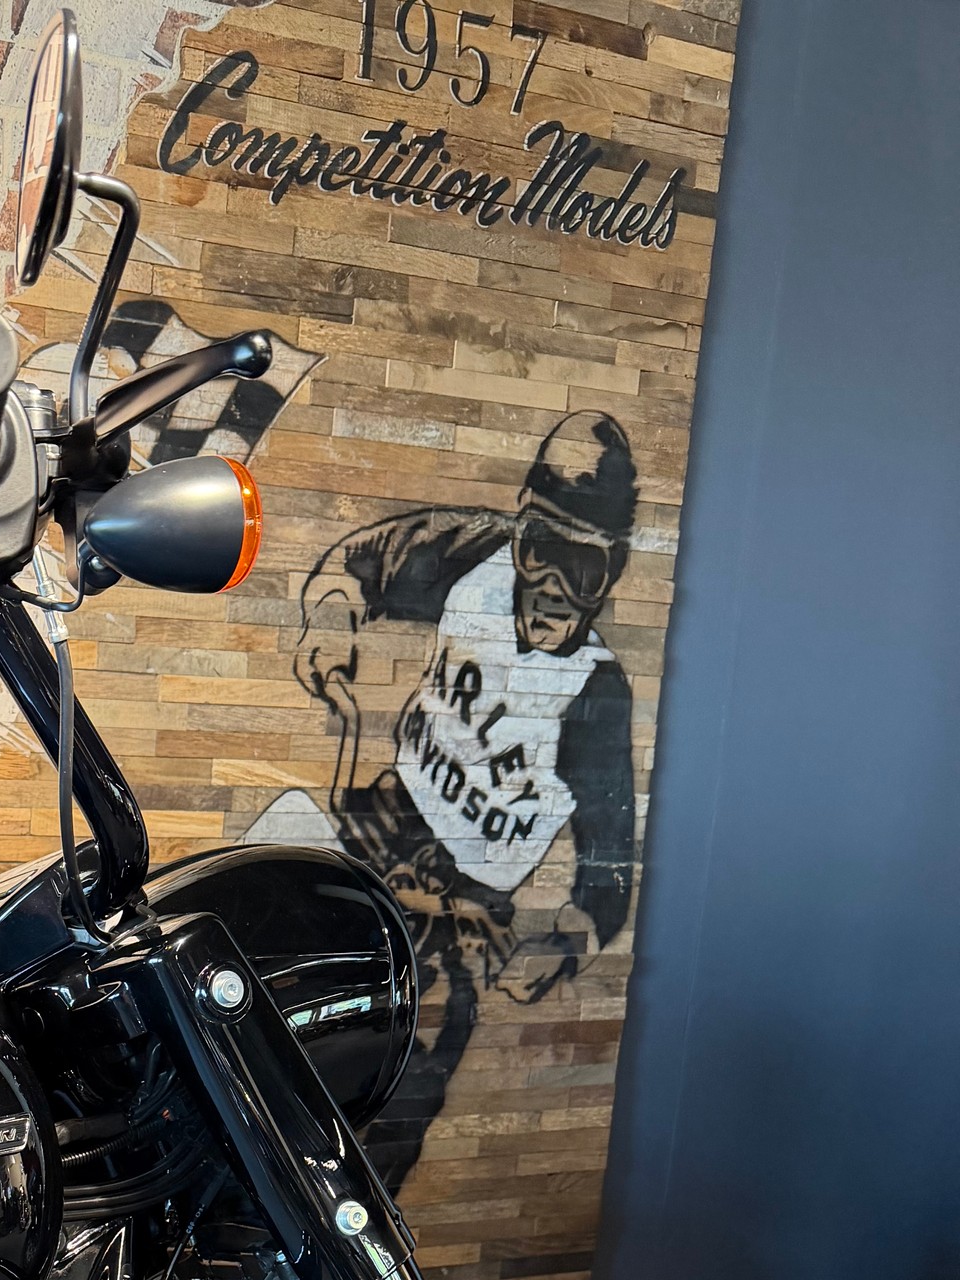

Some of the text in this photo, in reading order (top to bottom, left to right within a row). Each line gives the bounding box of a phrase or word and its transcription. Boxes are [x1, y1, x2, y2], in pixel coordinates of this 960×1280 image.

[355, 0, 549, 116] 1957
[156, 50, 512, 228] Competition
[509, 120, 688, 251] Models
